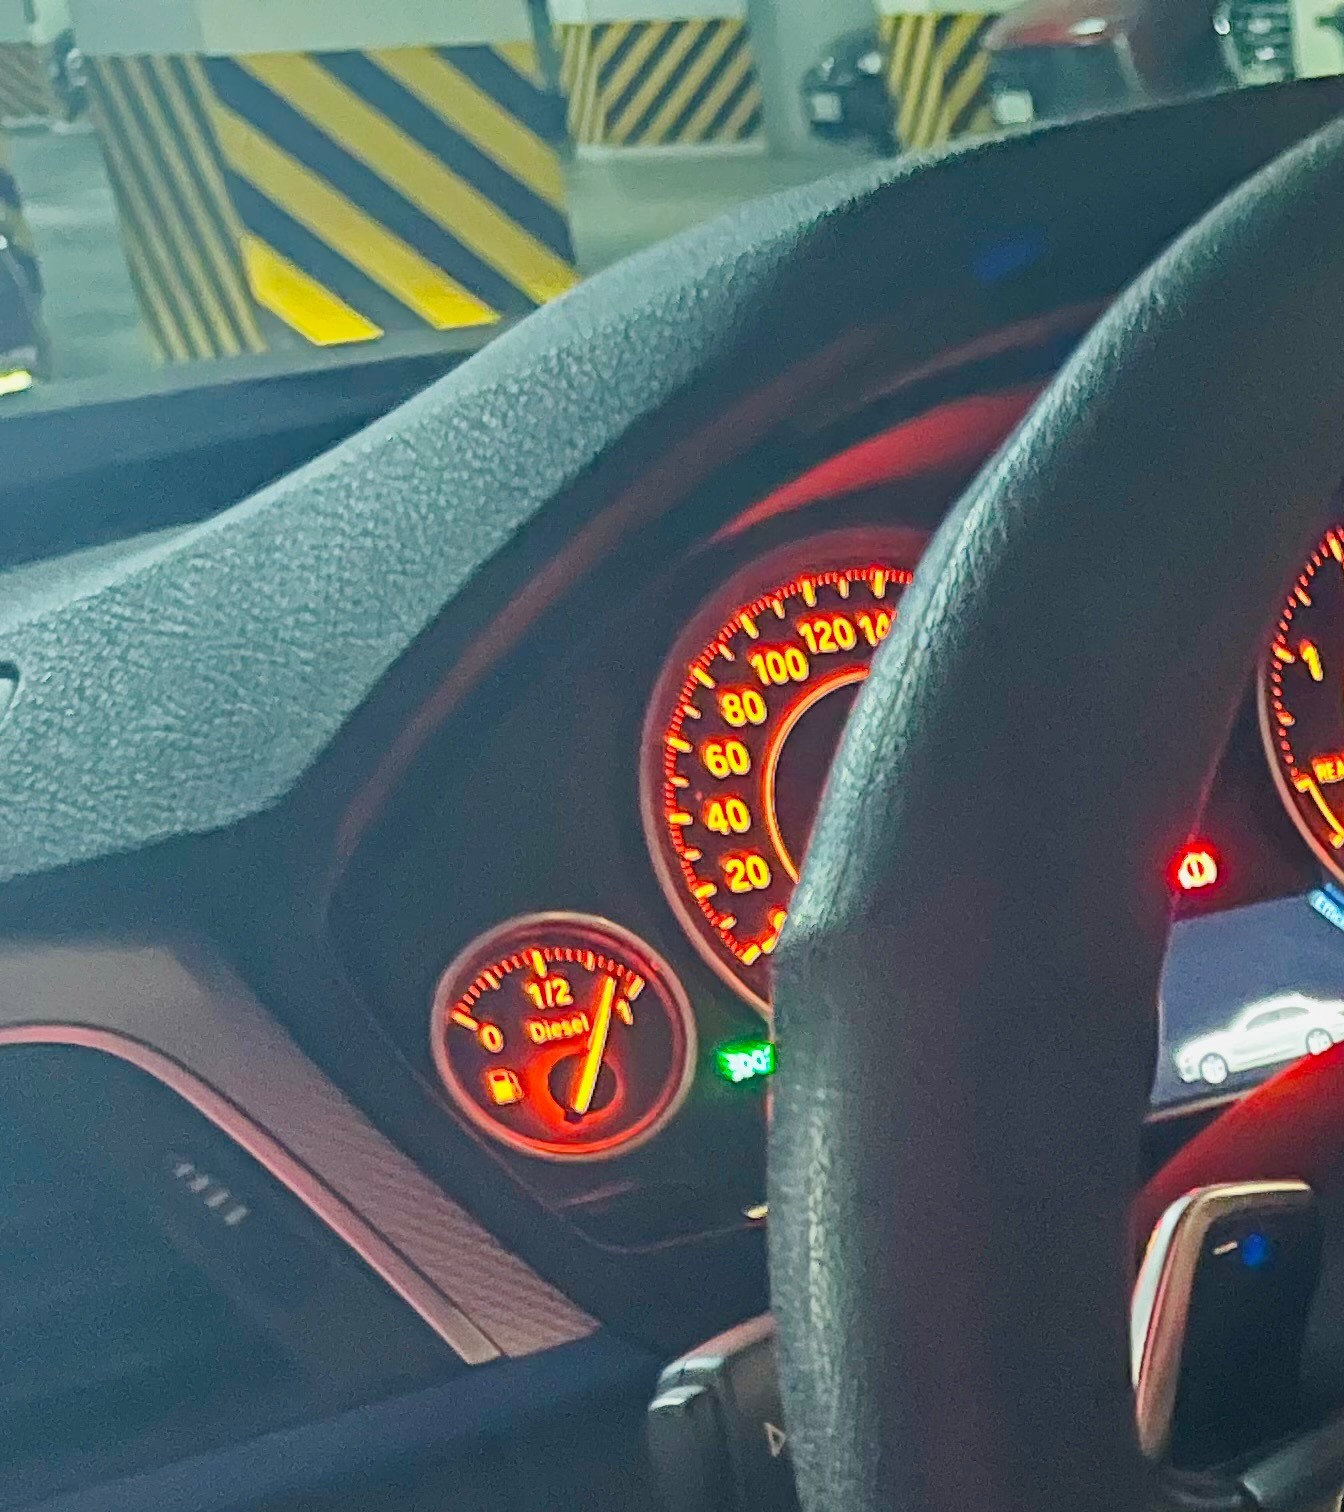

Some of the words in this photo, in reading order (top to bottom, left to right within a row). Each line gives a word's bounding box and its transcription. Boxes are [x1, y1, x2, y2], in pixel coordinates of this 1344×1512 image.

[799, 611, 856, 654] 120
[858, 613, 896, 647] 14
[750, 647, 809, 685] 100
[1302, 642, 1323, 681] 1
[720, 688, 767, 727] 80
[703, 738, 750, 778] 60
[705, 797, 750, 835] 40
[723, 853, 770, 893] 20
[527, 976, 574, 1009] 1/2
[479, 1022, 504, 1054] 0
[527, 1012, 590, 1044] Diesel
